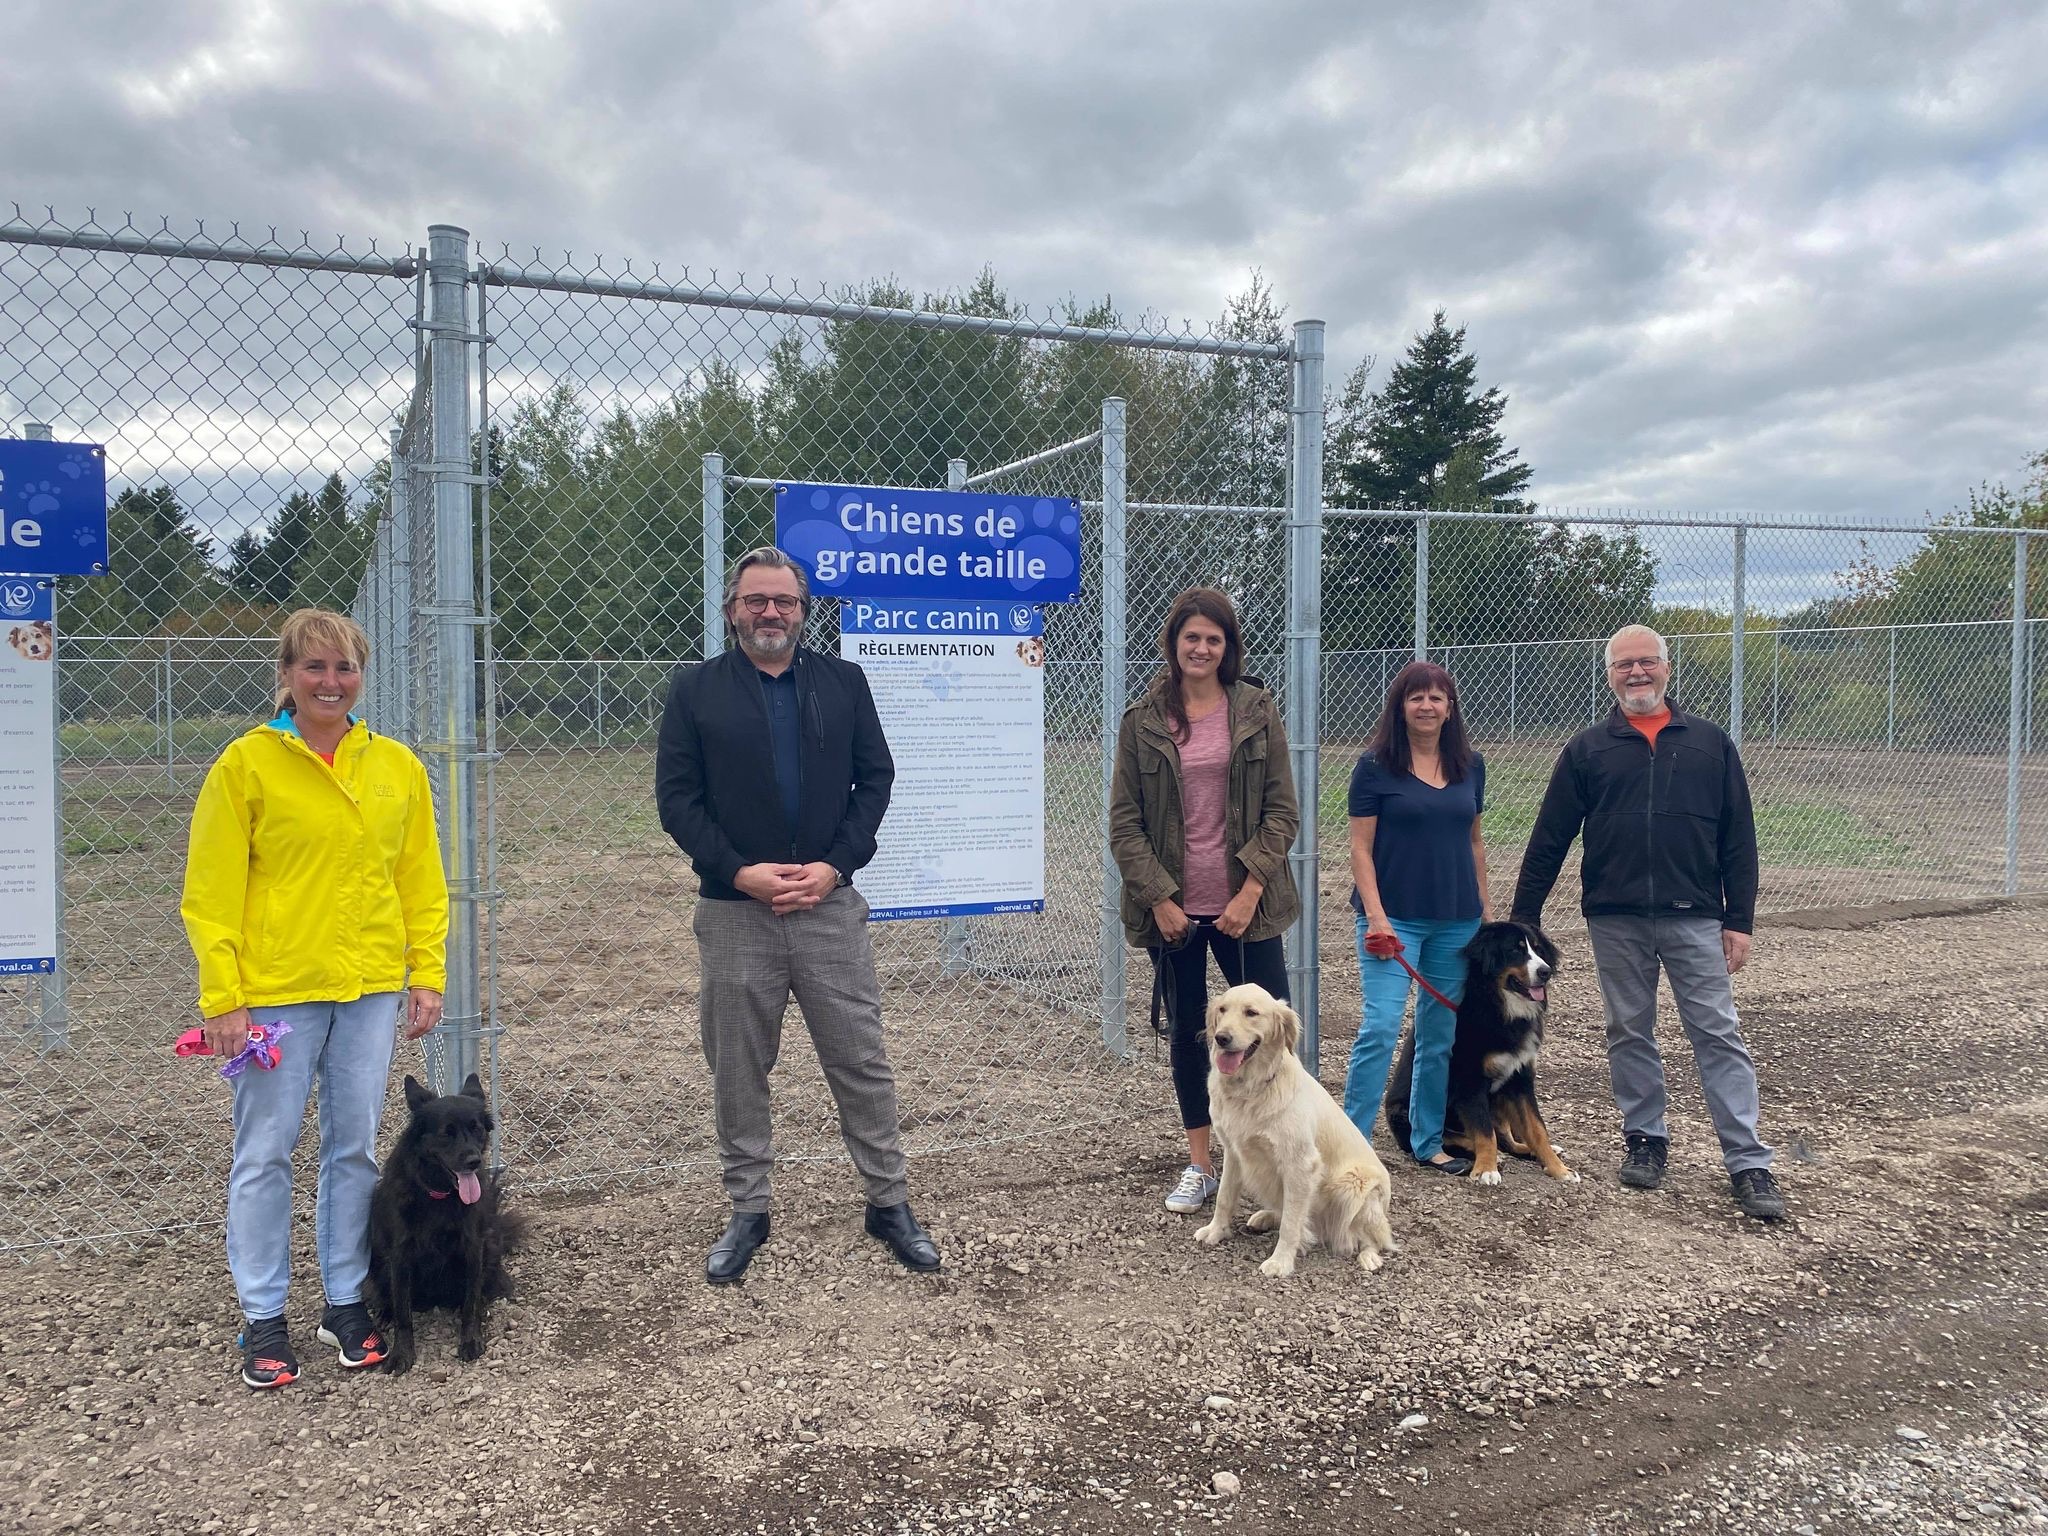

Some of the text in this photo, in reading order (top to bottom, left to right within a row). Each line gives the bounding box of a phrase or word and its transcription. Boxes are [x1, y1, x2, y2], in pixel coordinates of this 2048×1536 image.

[840, 502, 1016, 538] Chiens de
[815, 546, 1046, 581] grande taille
[856, 604, 999, 630] Parc canin
[859, 640, 995, 656] RÈGLEMENTATION
[899, 909, 922, 917] Fenêtre
[993, 904, 1031, 912] roberval.ca
